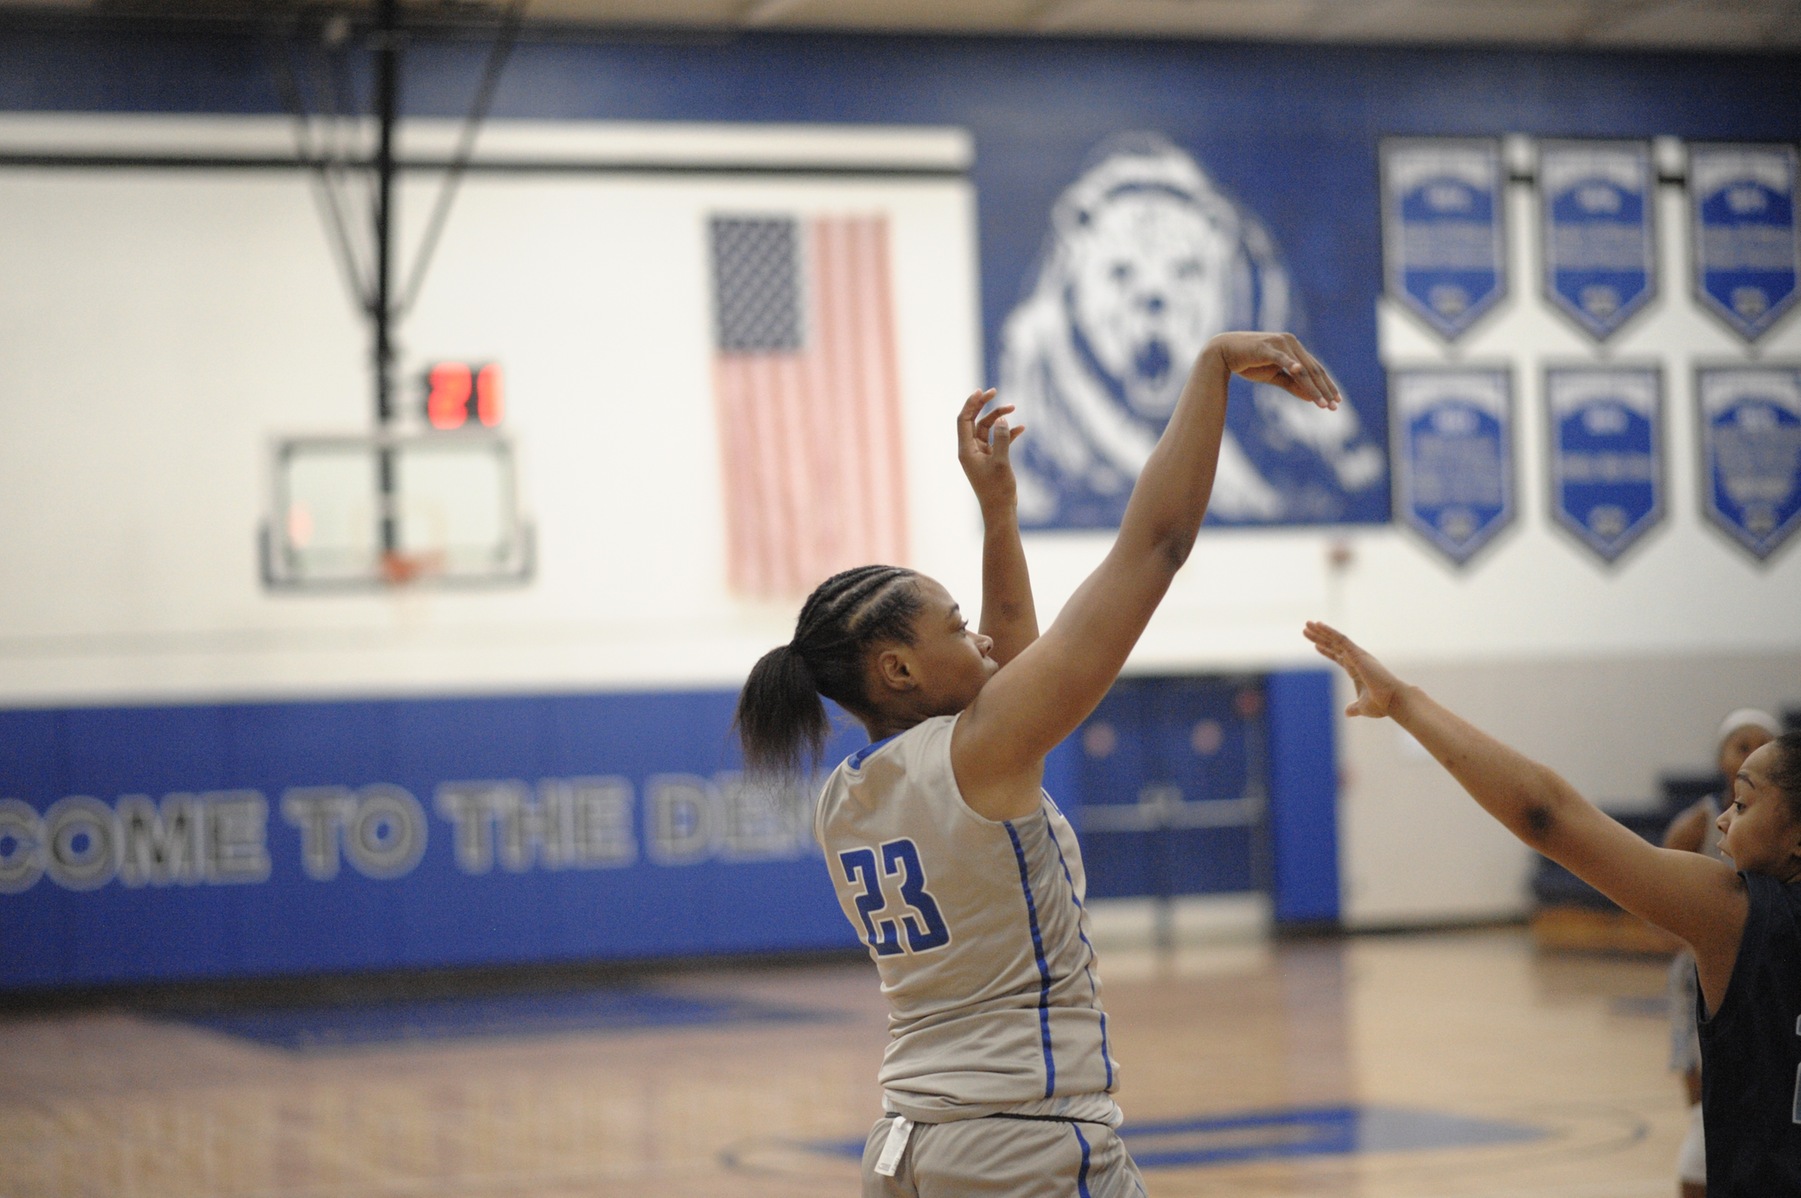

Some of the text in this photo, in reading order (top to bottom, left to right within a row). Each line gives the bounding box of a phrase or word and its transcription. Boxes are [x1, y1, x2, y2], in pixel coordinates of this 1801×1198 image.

[427, 362, 504, 430] 21
[281, 783, 427, 881] TO
[434, 775, 637, 874] THE
[645, 770, 816, 866] DE
[837, 836, 951, 957] 23
